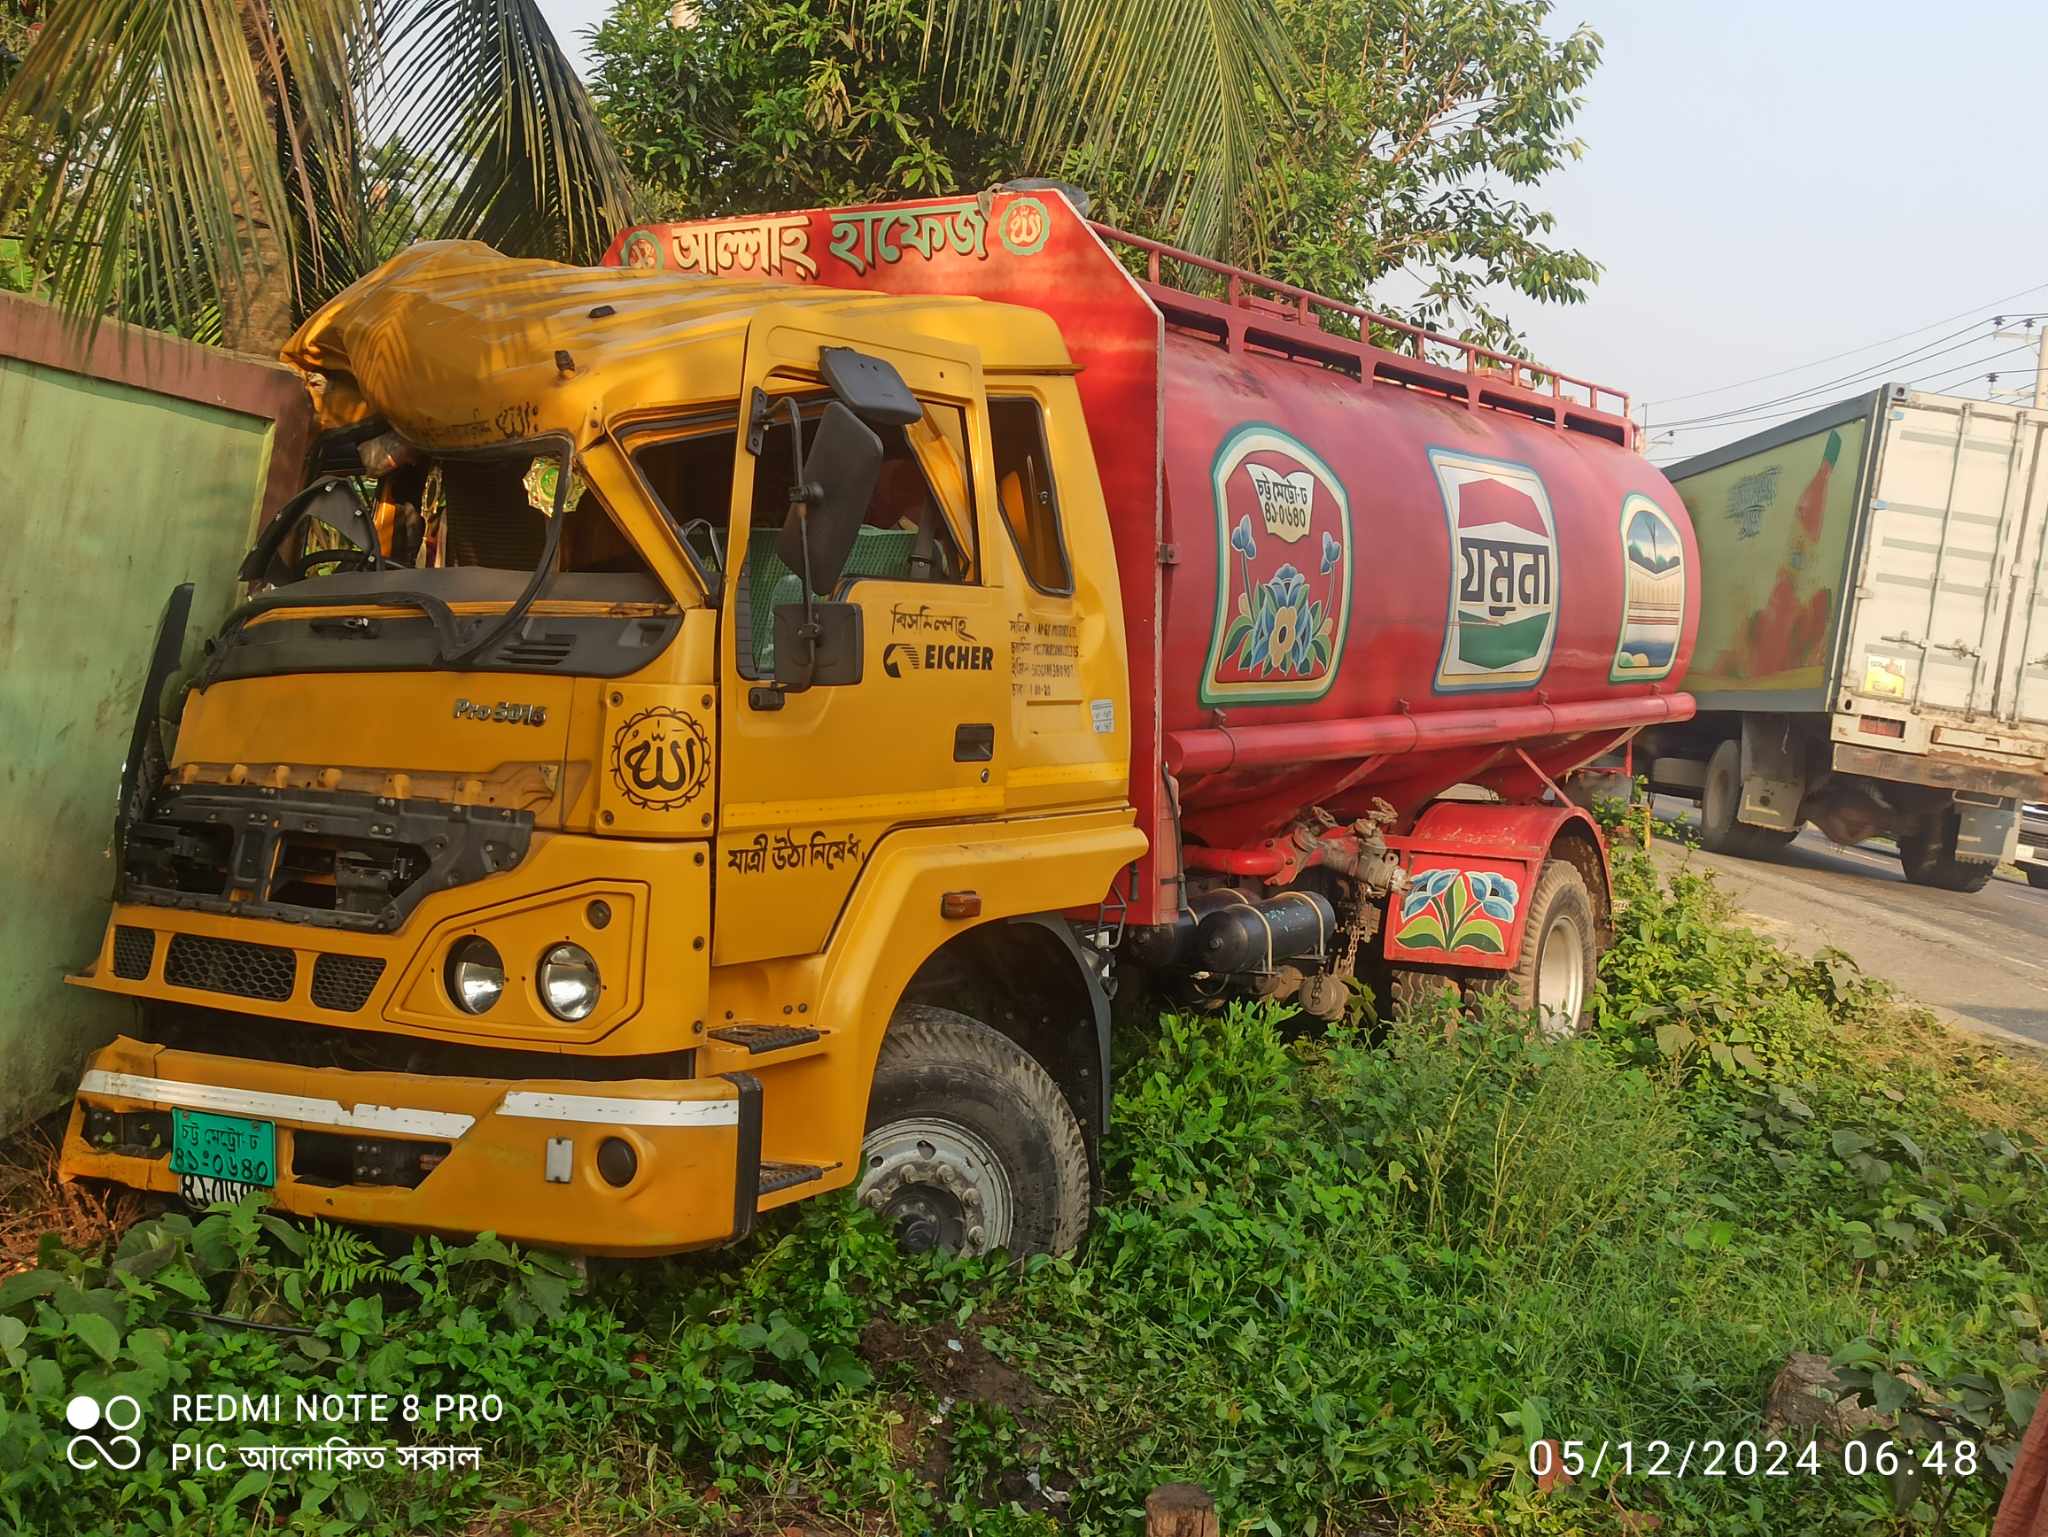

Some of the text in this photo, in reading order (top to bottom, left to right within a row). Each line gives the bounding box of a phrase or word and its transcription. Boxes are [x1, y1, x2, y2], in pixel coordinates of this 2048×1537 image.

[829, 202, 988, 276] হাফেজ
[1460, 536, 1550, 617] যমুনা
[924, 644, 994, 671] EICHER
[453, 698, 491, 722] Pro
[727, 832, 769, 875] যাত্রী
[771, 826, 808, 871] উঠা
